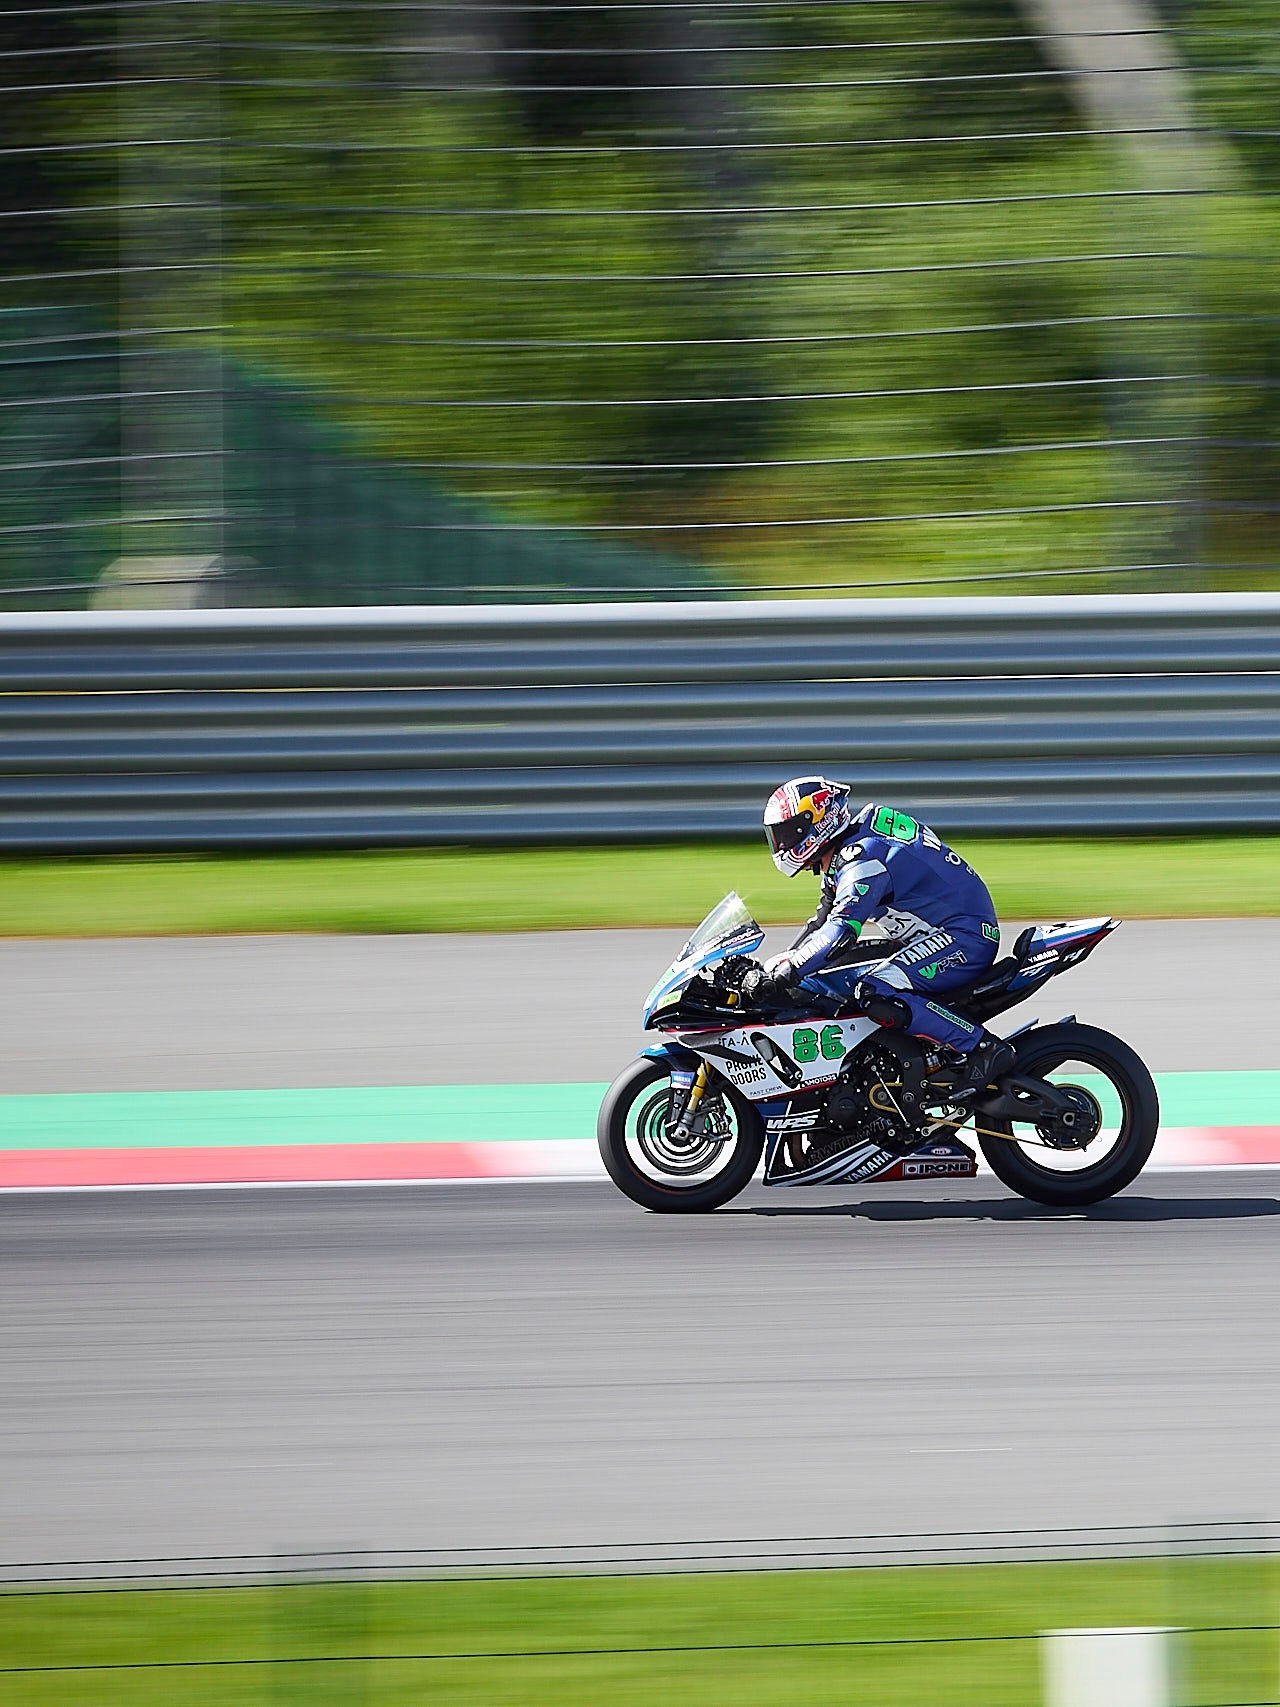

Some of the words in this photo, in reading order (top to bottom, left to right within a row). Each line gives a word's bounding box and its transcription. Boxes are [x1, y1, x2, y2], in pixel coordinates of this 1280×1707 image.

[1028, 948, 1059, 963] YAMAHA
[792, 1025, 847, 1063] 86
[730, 1067, 767, 1085] DOORS
[767, 1114, 818, 1128] WRS
[843, 1151, 893, 1182] YAMAHA
[919, 1162, 970, 1174] IPONE
